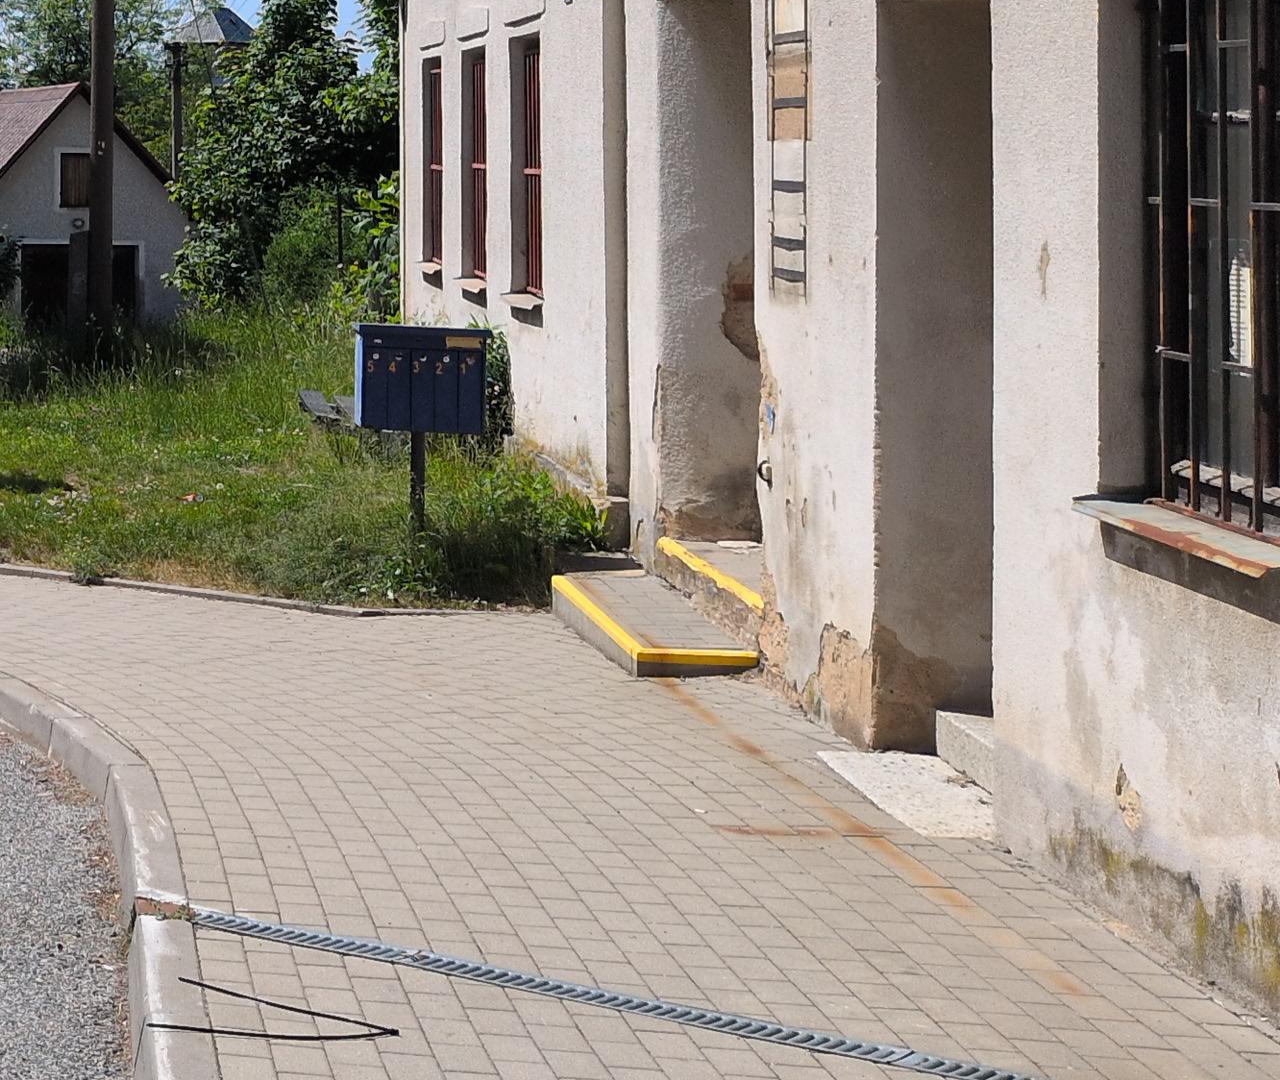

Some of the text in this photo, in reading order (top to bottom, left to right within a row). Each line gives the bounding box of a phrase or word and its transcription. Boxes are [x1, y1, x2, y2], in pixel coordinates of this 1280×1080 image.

[368, 360, 466, 375] 5 4 3 2 1
